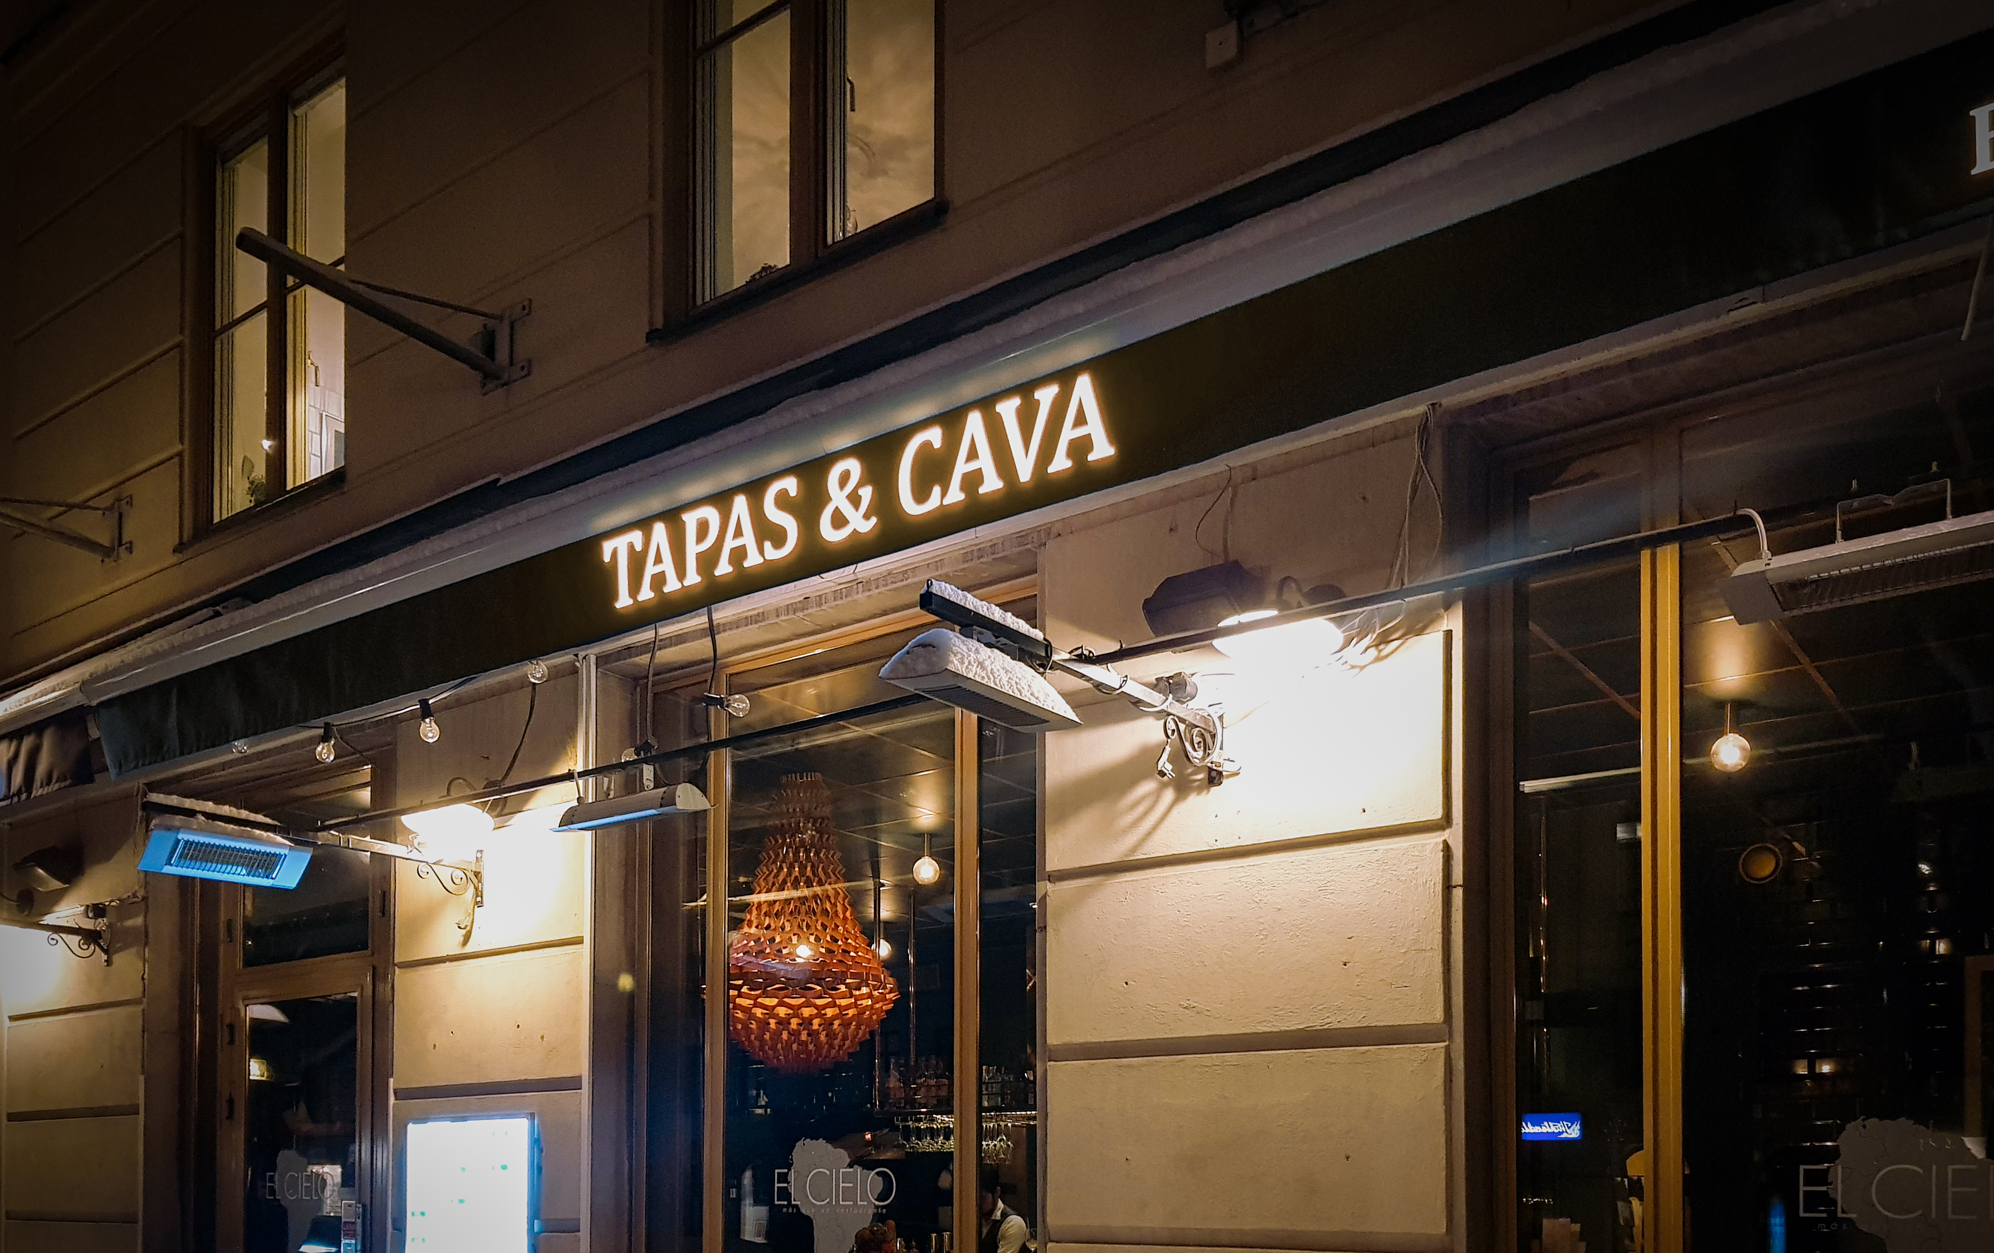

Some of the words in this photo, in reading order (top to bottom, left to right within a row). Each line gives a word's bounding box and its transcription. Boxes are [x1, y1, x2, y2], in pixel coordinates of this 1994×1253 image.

[603, 475, 799, 610] TAPAS
[818, 456, 878, 543] &
[898, 372, 1116, 516] CAVA
[266, 1172, 281, 1199] EL
[285, 1172, 334, 1200] CIELO
[774, 1168, 801, 1205] EL
[806, 1167, 897, 1206] CIELO
[1799, 1164, 1858, 1218] EL
